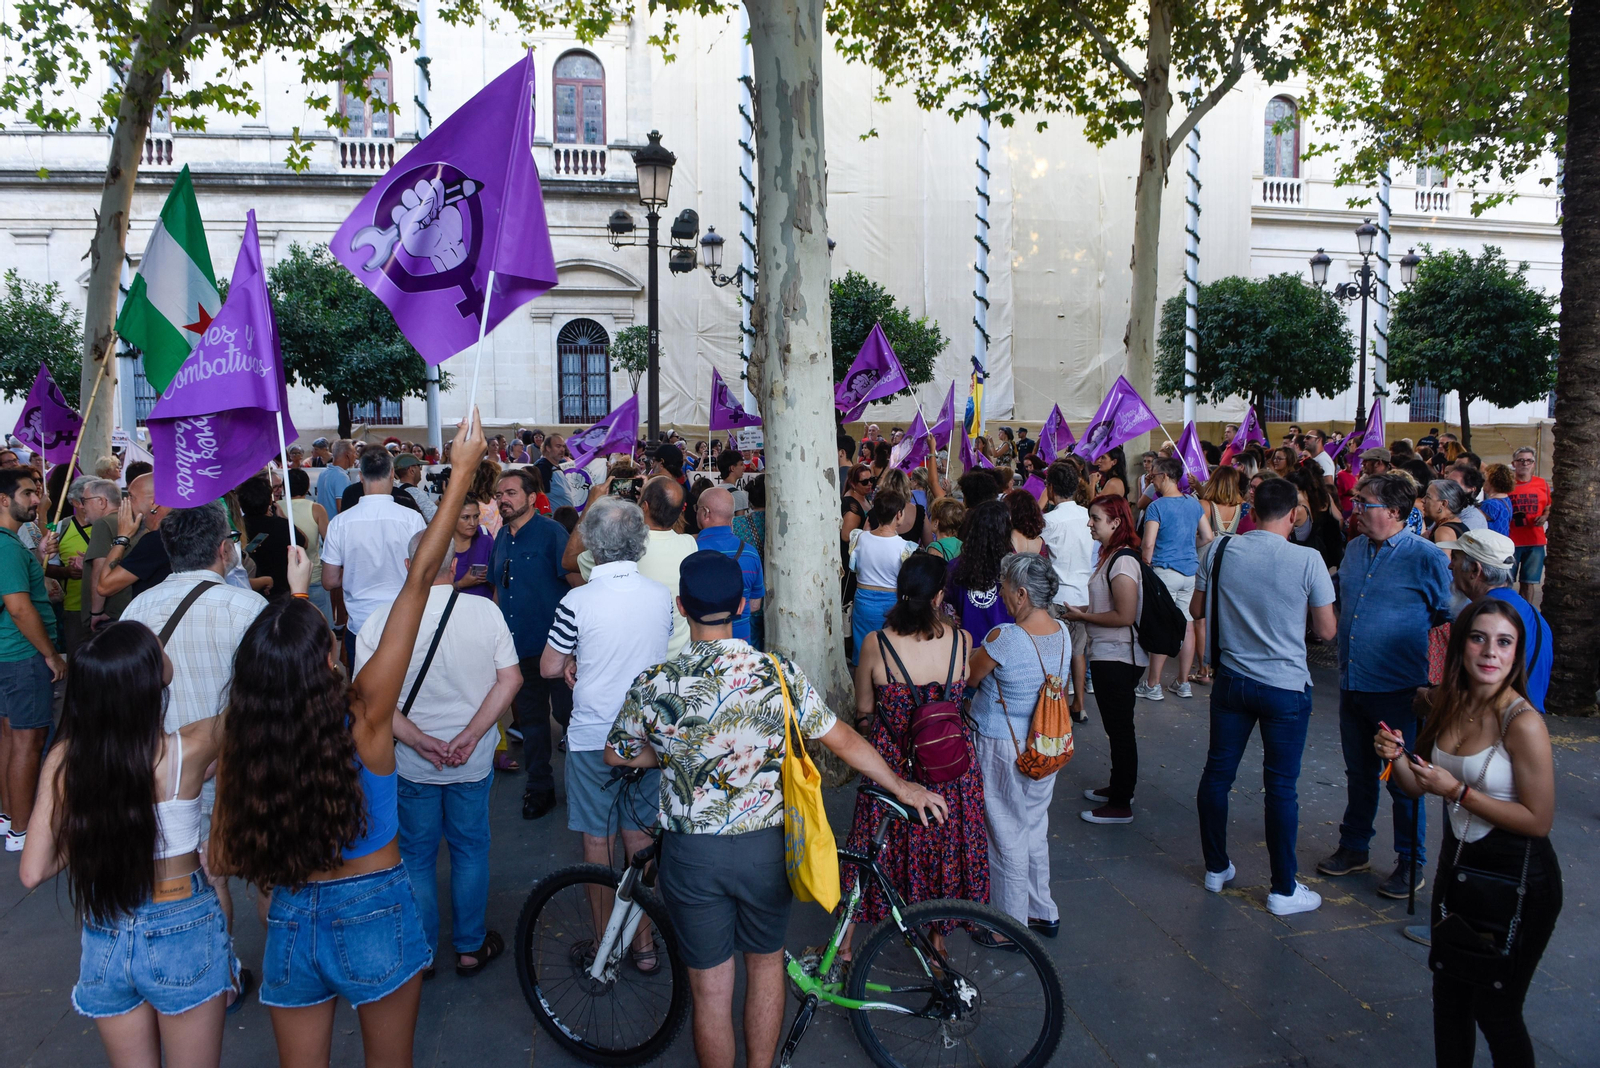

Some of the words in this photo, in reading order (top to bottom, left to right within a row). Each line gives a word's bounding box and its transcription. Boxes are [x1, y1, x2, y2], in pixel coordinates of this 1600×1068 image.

[245, 324, 255, 350] y
[189, 413, 219, 460] bres
[174, 421, 201, 501] bativas
[196, 465, 222, 479] y
